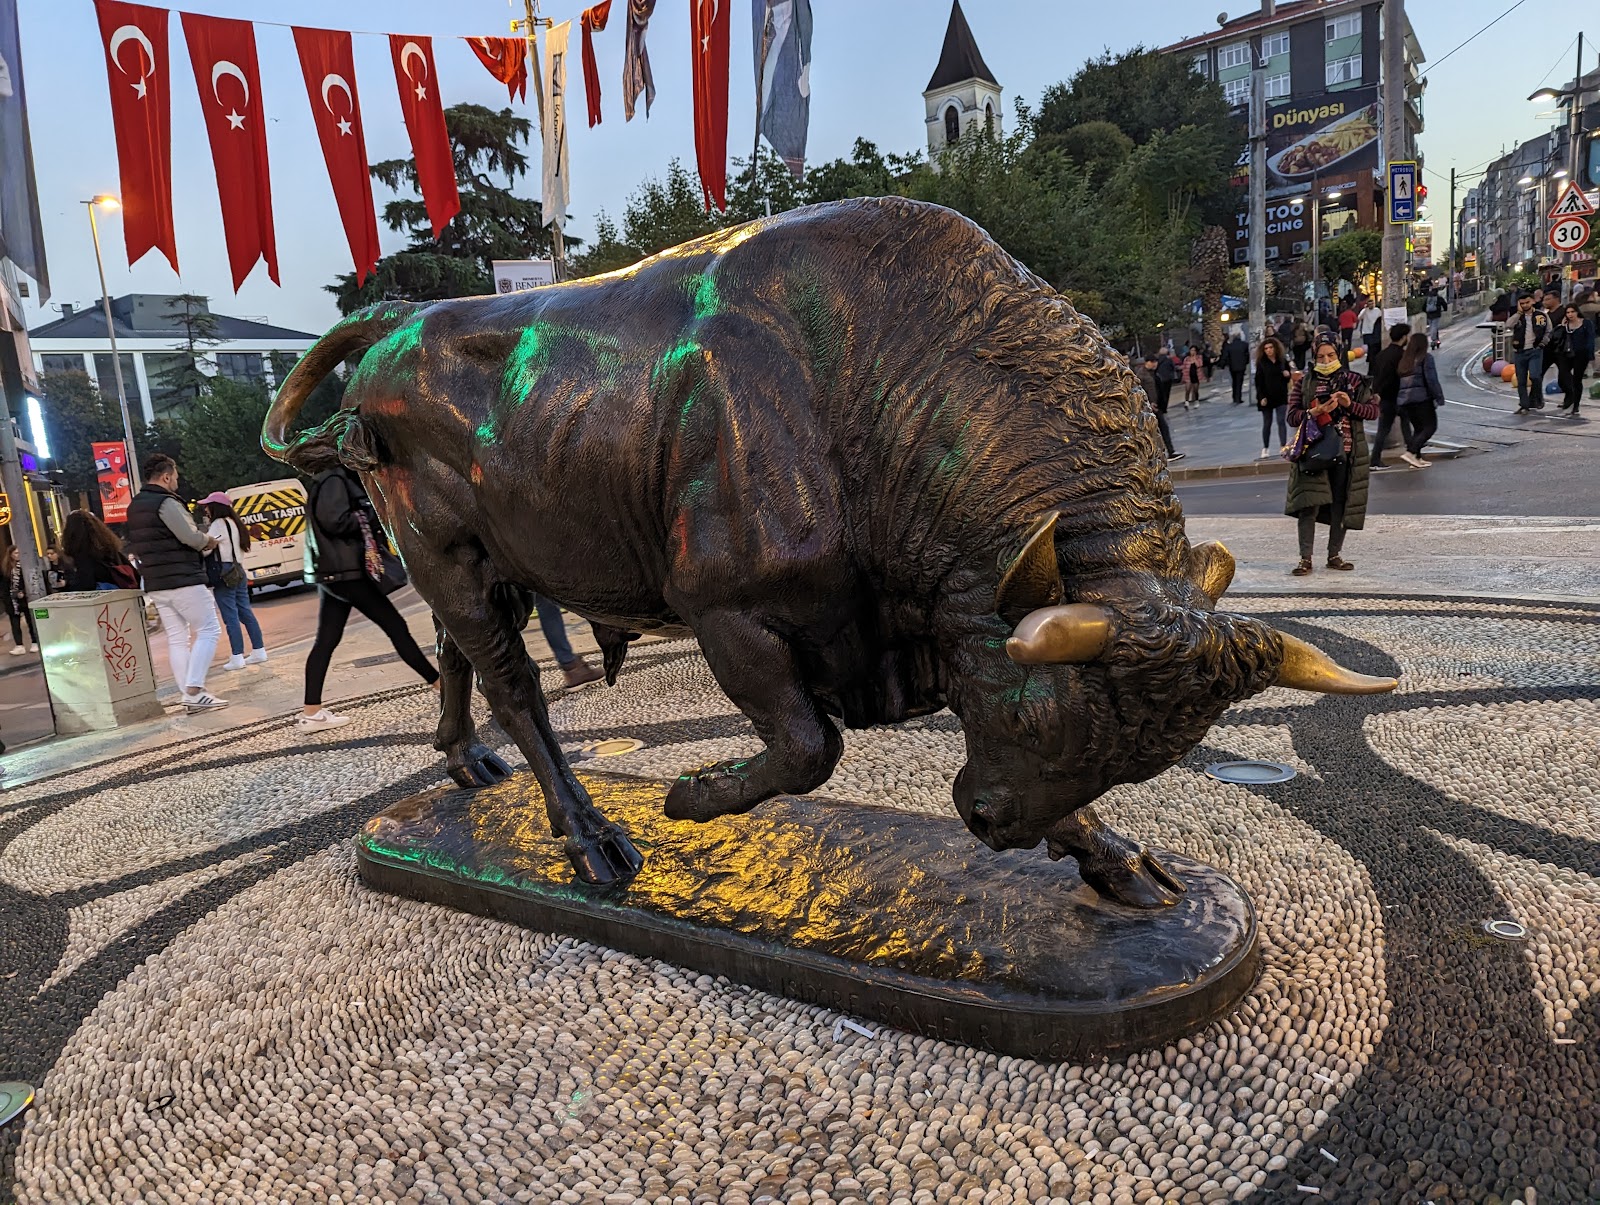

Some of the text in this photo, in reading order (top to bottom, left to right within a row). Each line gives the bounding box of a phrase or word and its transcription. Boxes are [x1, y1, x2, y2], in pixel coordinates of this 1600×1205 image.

[1273, 102, 1345, 128] Dünyası
[1235, 203, 1304, 226] TTOO
[1235, 218, 1304, 240] PICING
[1557, 225, 1582, 243] 30
[241, 505, 306, 525] OKUL TAŞITI
[268, 536, 295, 547] ŞAFAK
